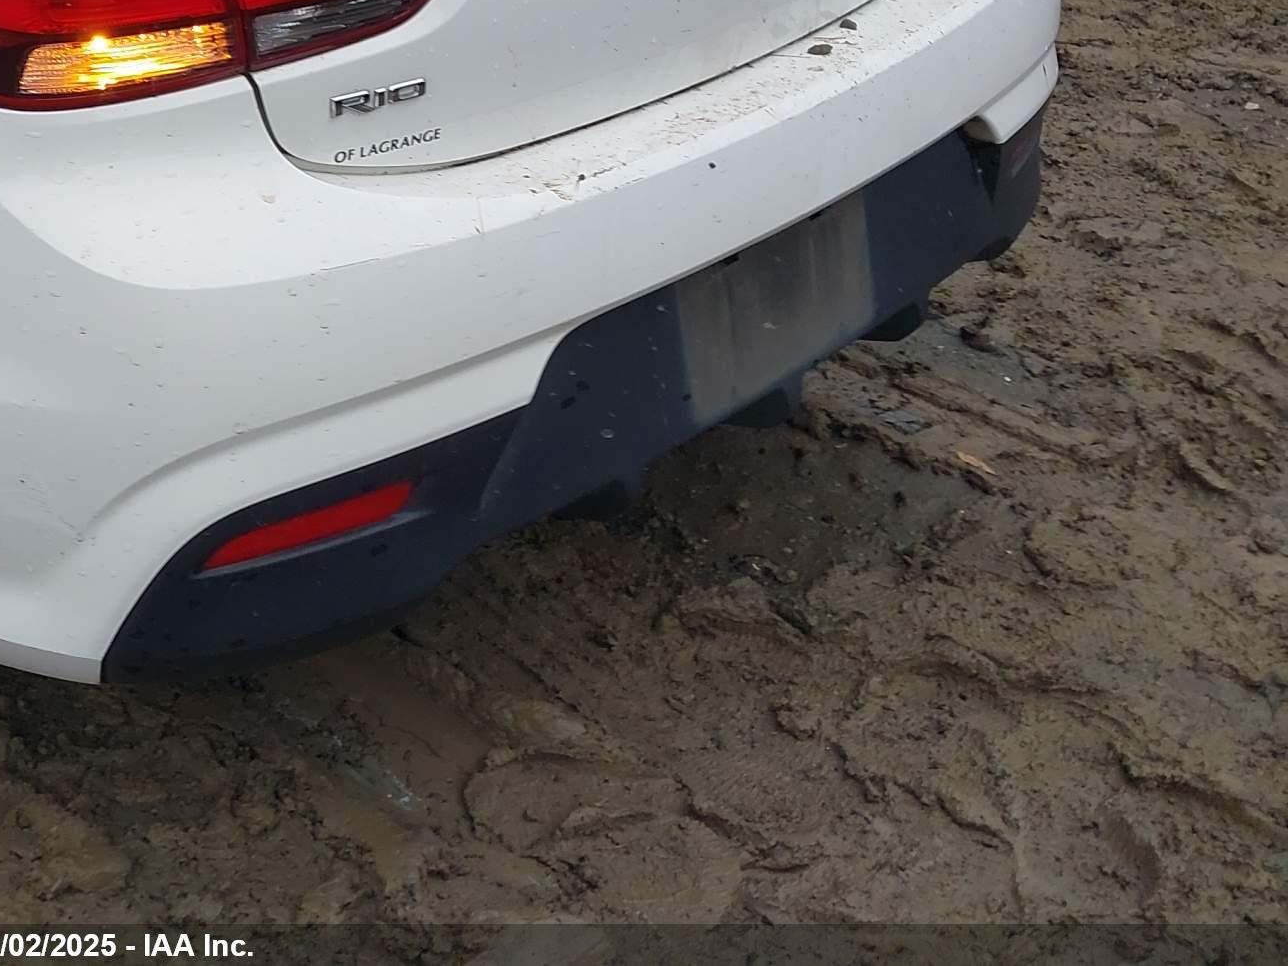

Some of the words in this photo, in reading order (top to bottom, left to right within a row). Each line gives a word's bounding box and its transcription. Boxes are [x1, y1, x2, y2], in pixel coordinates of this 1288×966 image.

[329, 77, 426, 119] RIO
[334, 149, 355, 163] OF
[359, 128, 442, 158] LAGRANGE
